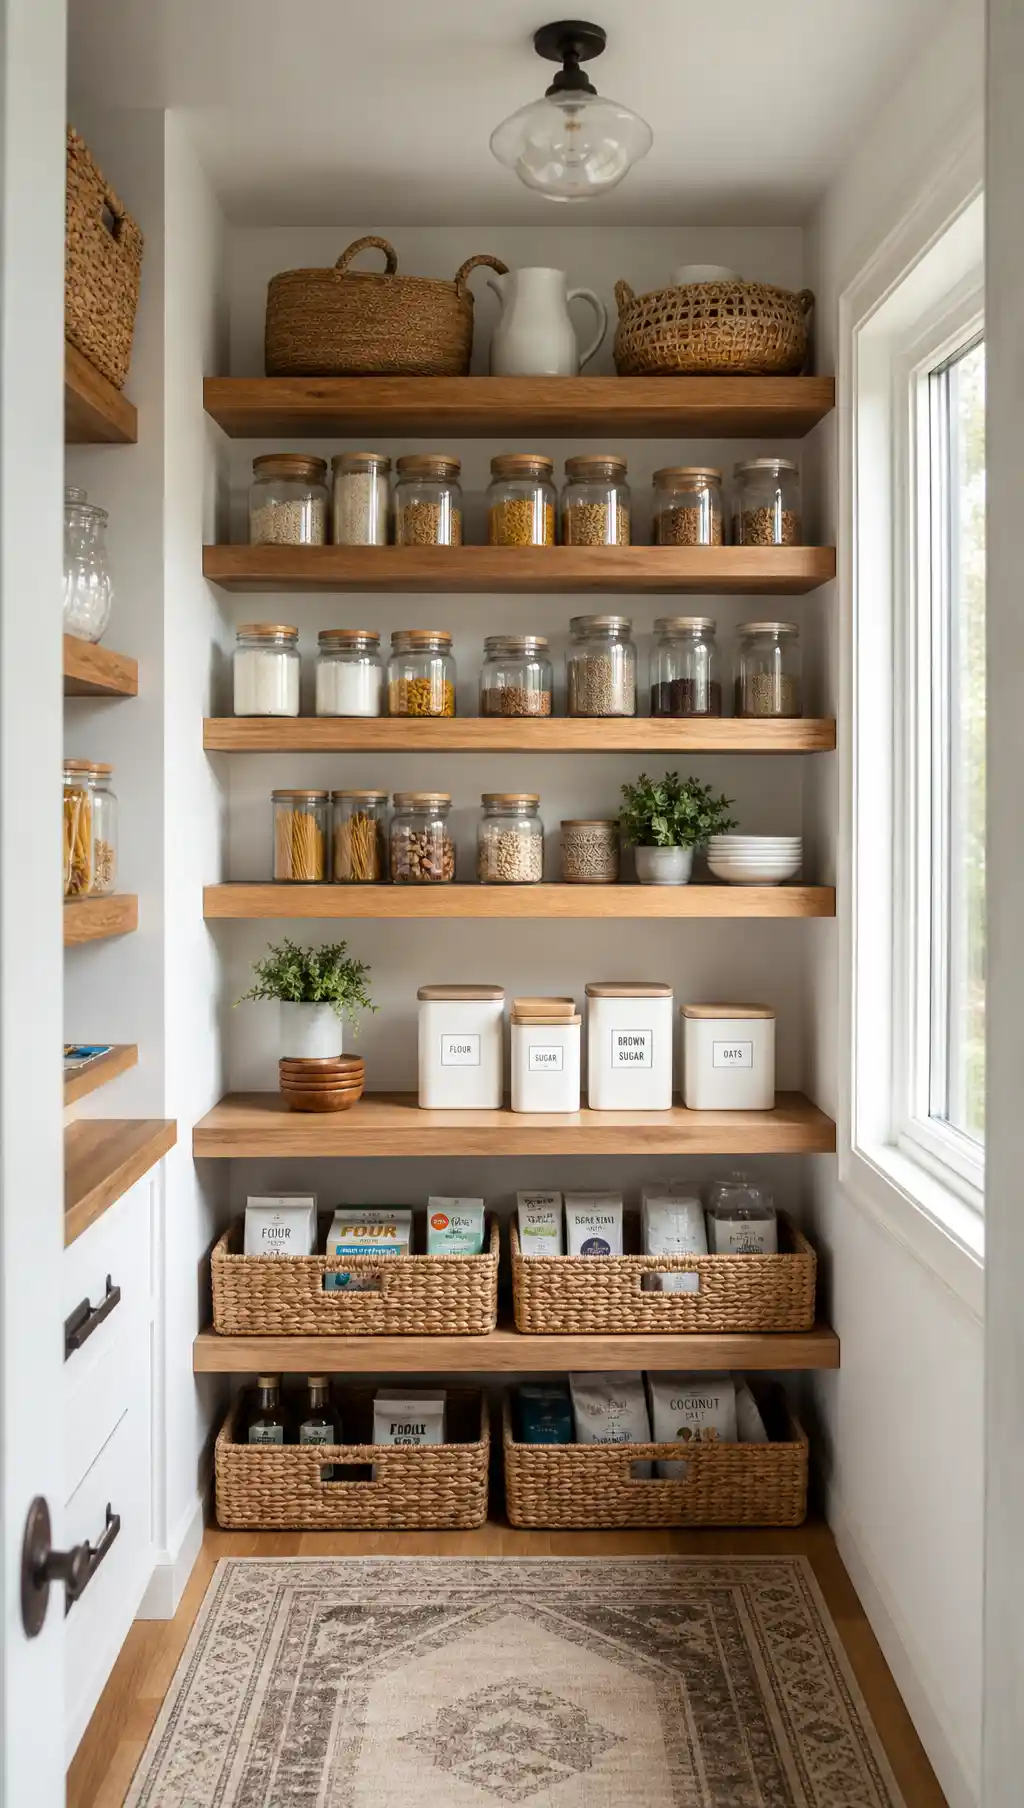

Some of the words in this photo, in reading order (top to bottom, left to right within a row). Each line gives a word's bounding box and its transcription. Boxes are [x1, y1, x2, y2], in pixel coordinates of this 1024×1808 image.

[617, 1036, 645, 1047] BROWN
[449, 1045, 472, 1055] FLOUR
[723, 1049, 743, 1060] OATS
[534, 1053, 557, 1063] SUGAR
[618, 1051, 644, 1062] SUGAR
[340, 1225, 397, 1239] FOUR
[669, 1397, 720, 1411] COCONUT
